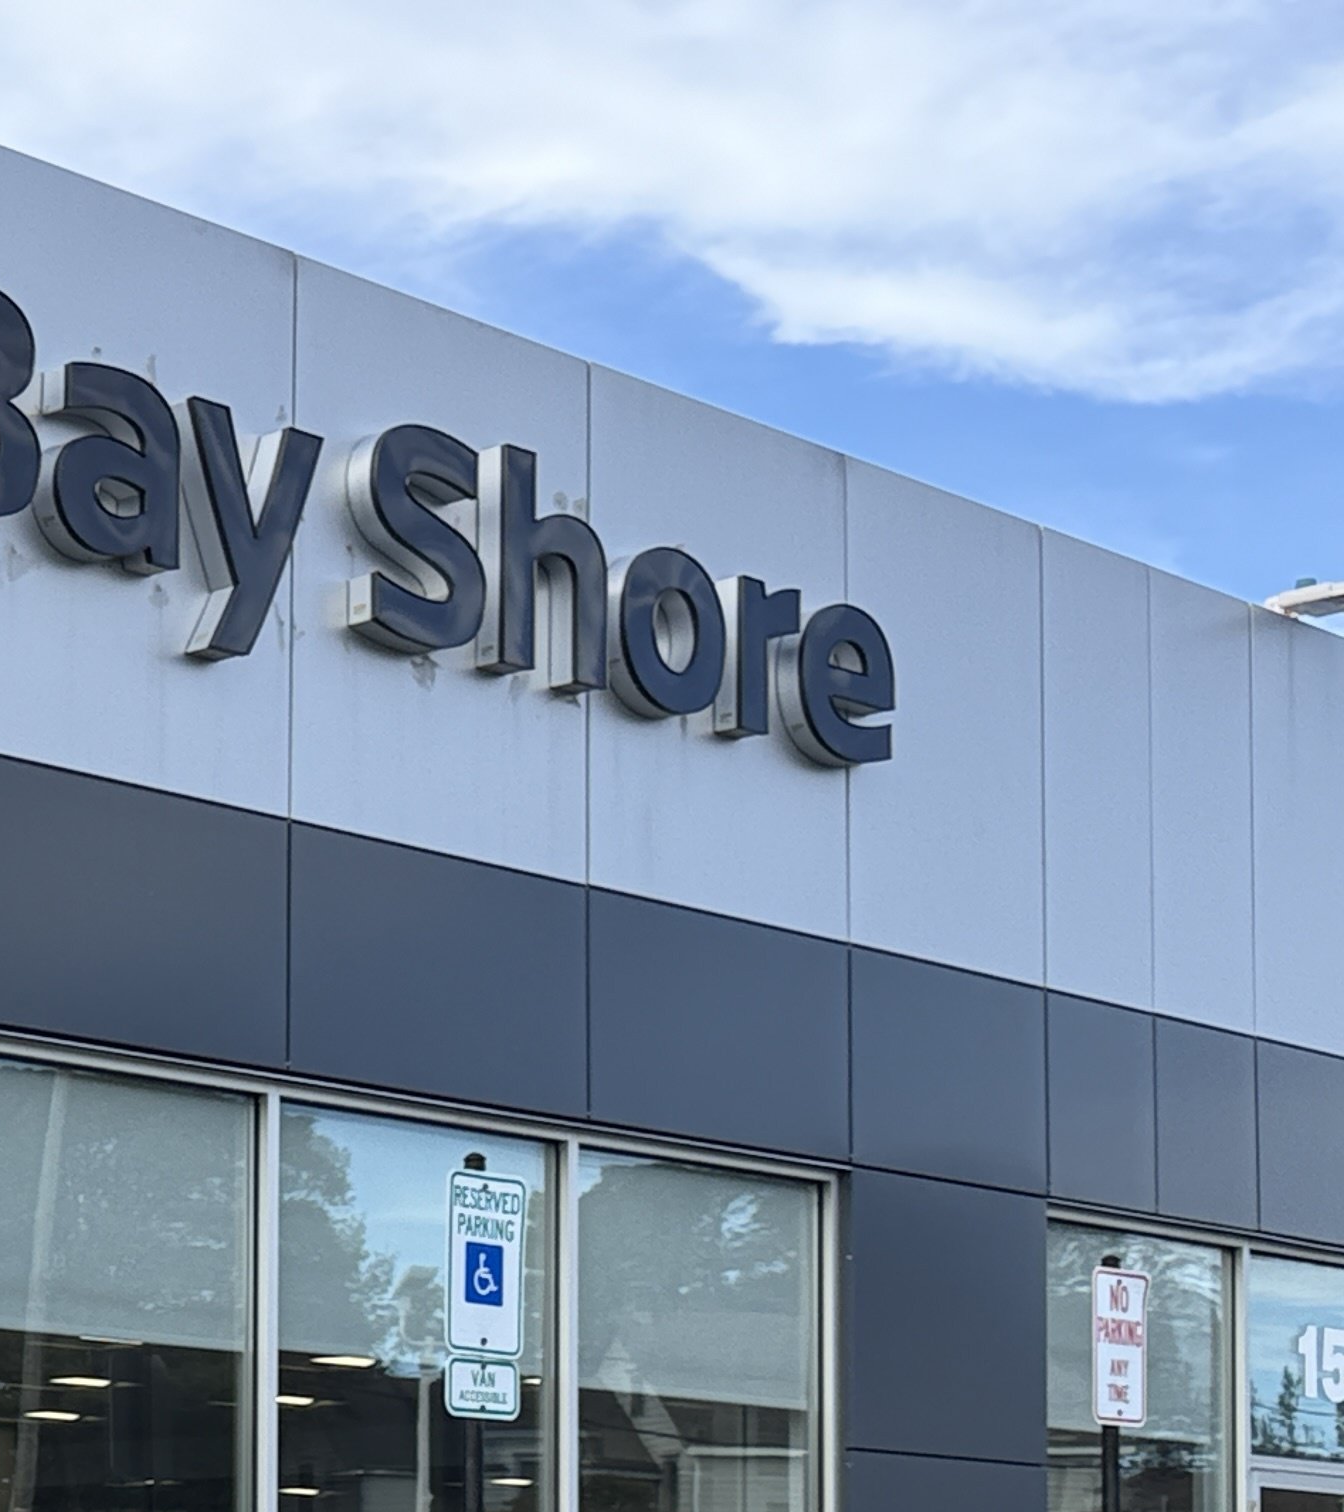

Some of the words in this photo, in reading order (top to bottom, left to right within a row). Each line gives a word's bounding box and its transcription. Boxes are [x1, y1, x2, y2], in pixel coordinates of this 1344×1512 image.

[347, 424, 895, 768] Shore
[453, 1184, 520, 1215] RESERVED
[457, 1212, 515, 1242] PARKING
[1108, 1284, 1130, 1313] NO
[1096, 1316, 1144, 1348] PARKING
[470, 1369, 496, 1388] VAN
[1109, 1359, 1130, 1377] ANY
[458, 1389, 508, 1405] ACCESSIBLE
[1106, 1383, 1130, 1404] TIME
